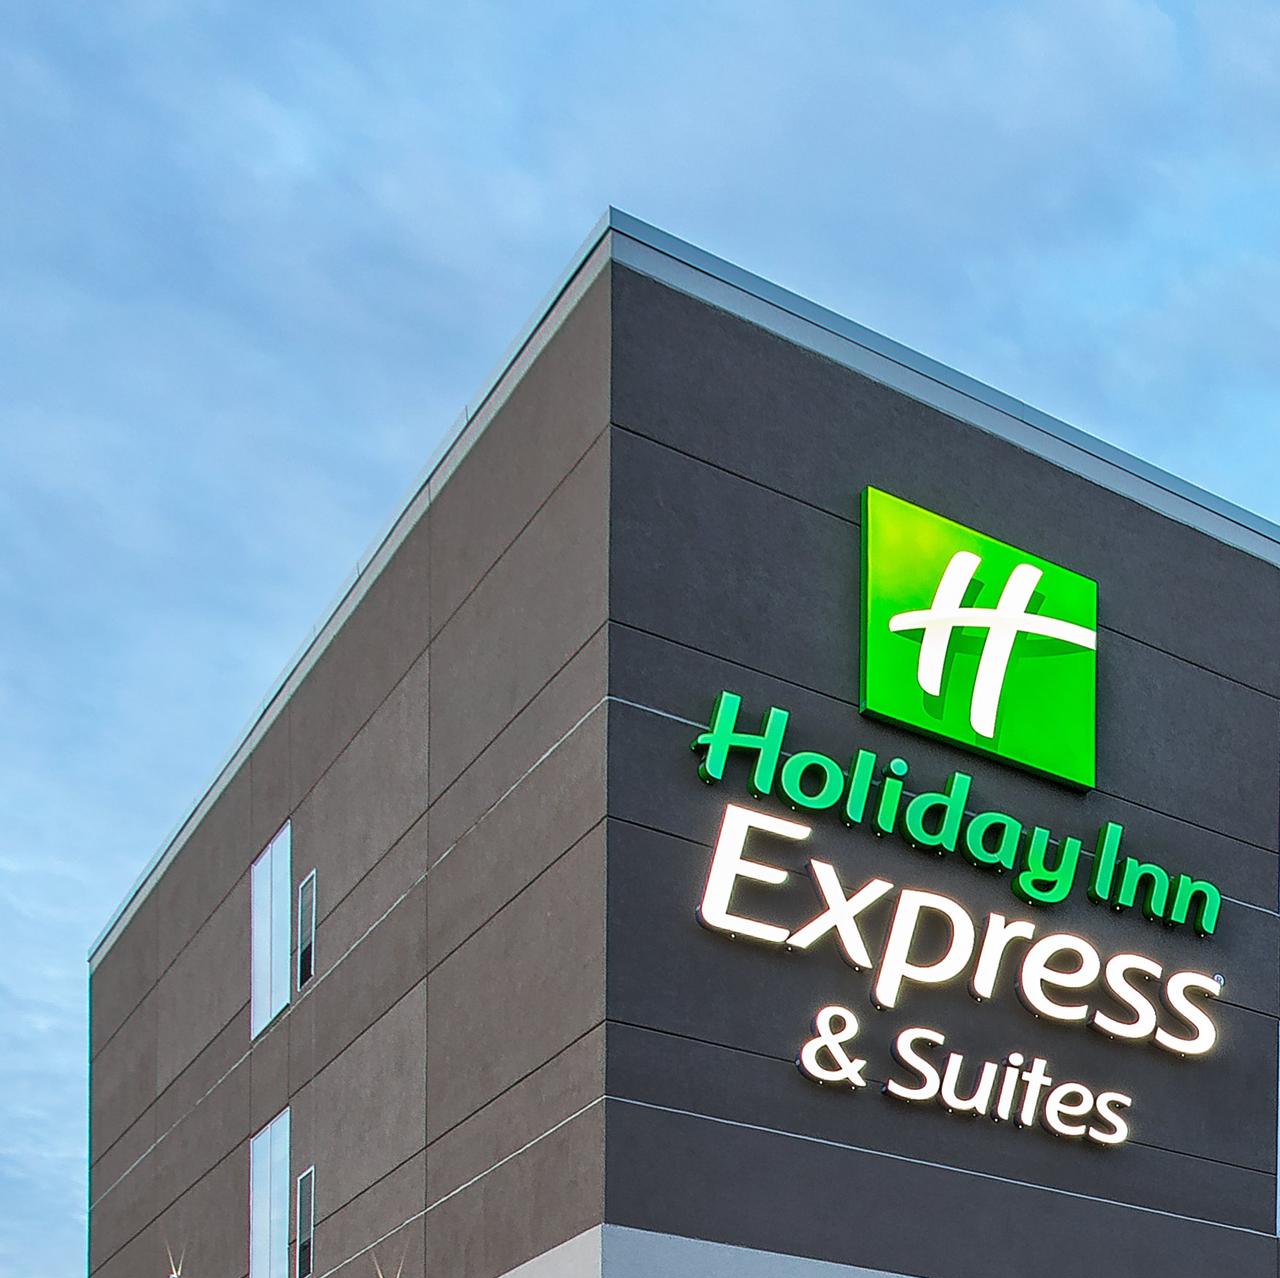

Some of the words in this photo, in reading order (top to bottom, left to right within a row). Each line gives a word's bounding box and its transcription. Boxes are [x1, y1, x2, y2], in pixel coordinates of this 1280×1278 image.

[692, 689, 1081, 905] Holiday
[1092, 820, 1222, 936] Inn
[697, 802, 1222, 1058] Express
[798, 1005, 867, 1088] &
[884, 1025, 1133, 1146] Suites
